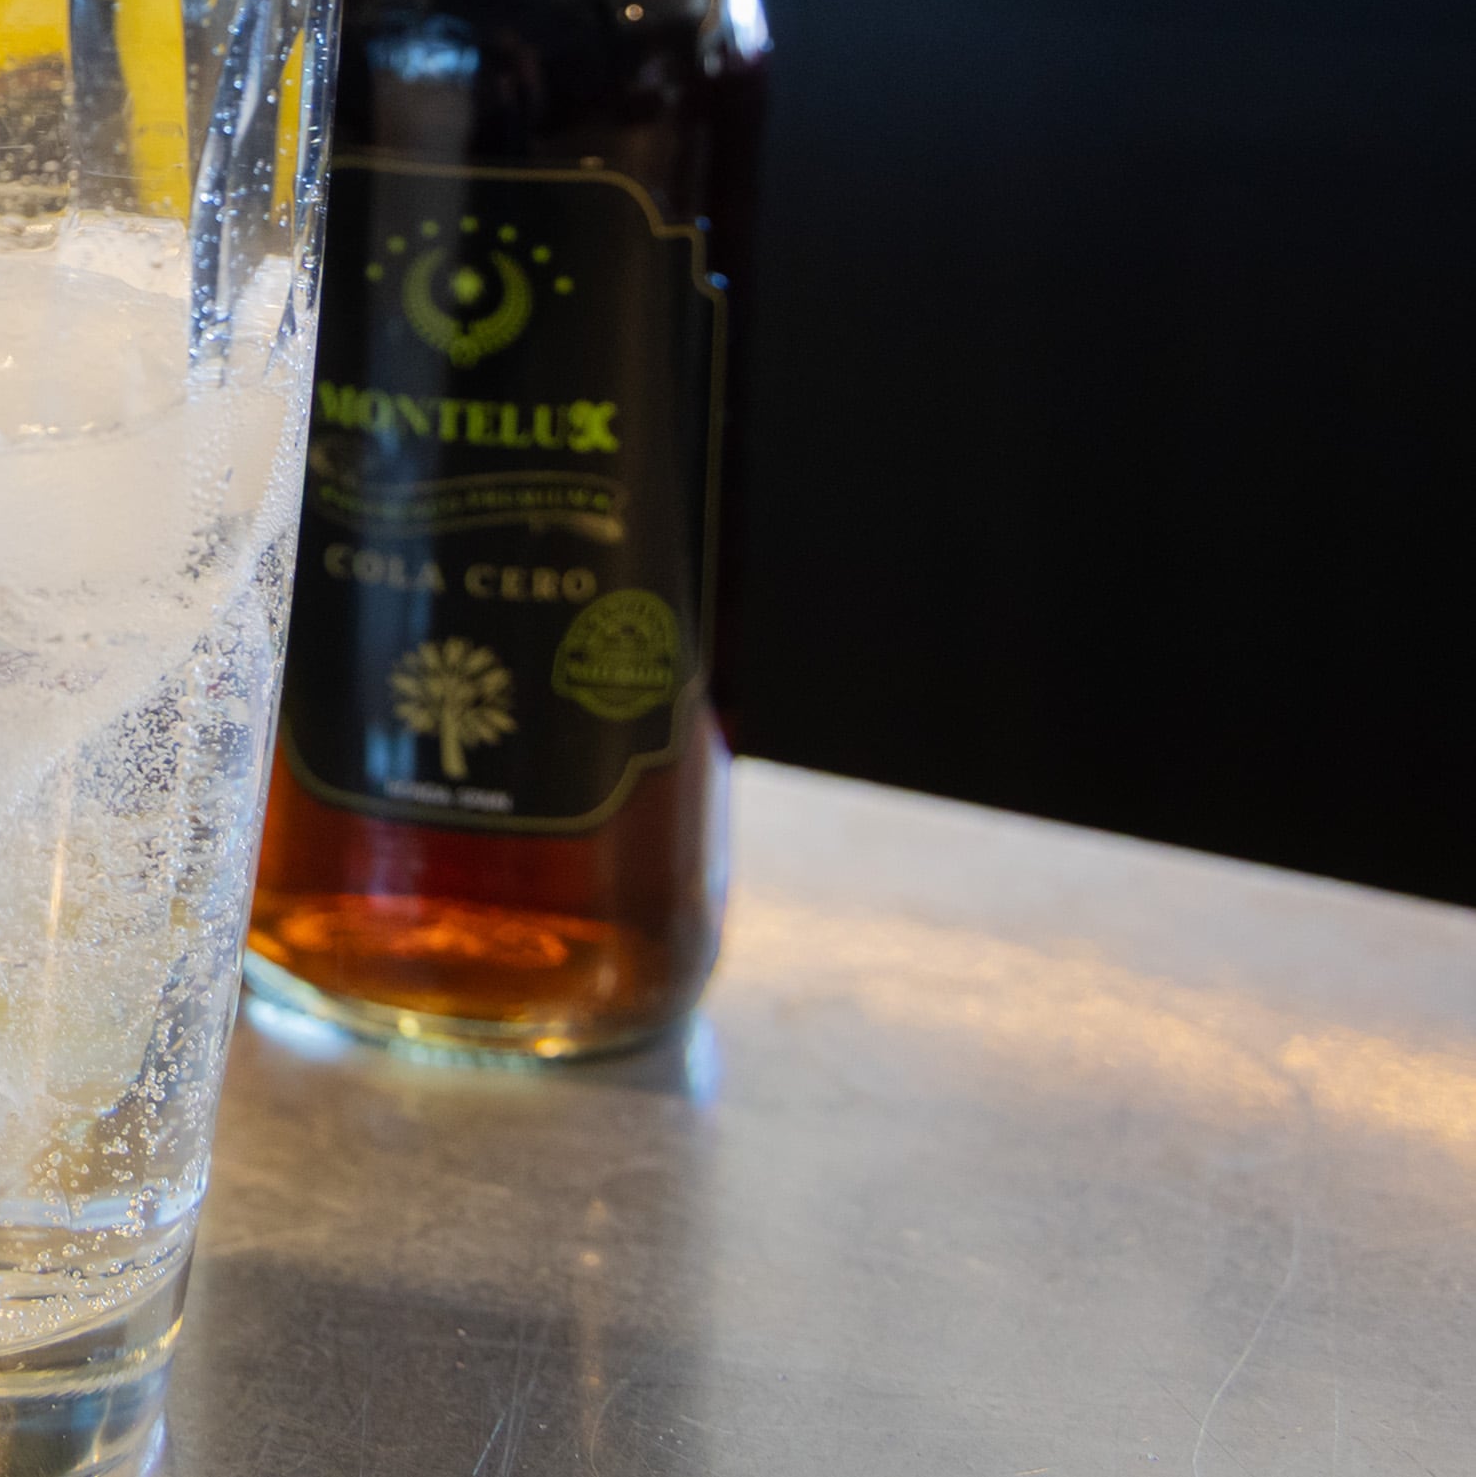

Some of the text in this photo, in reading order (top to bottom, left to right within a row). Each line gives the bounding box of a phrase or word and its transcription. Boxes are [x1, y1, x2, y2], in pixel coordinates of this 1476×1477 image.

[317, 379, 621, 456] MONTELUX
[323, 542, 599, 605] COLA CERO
